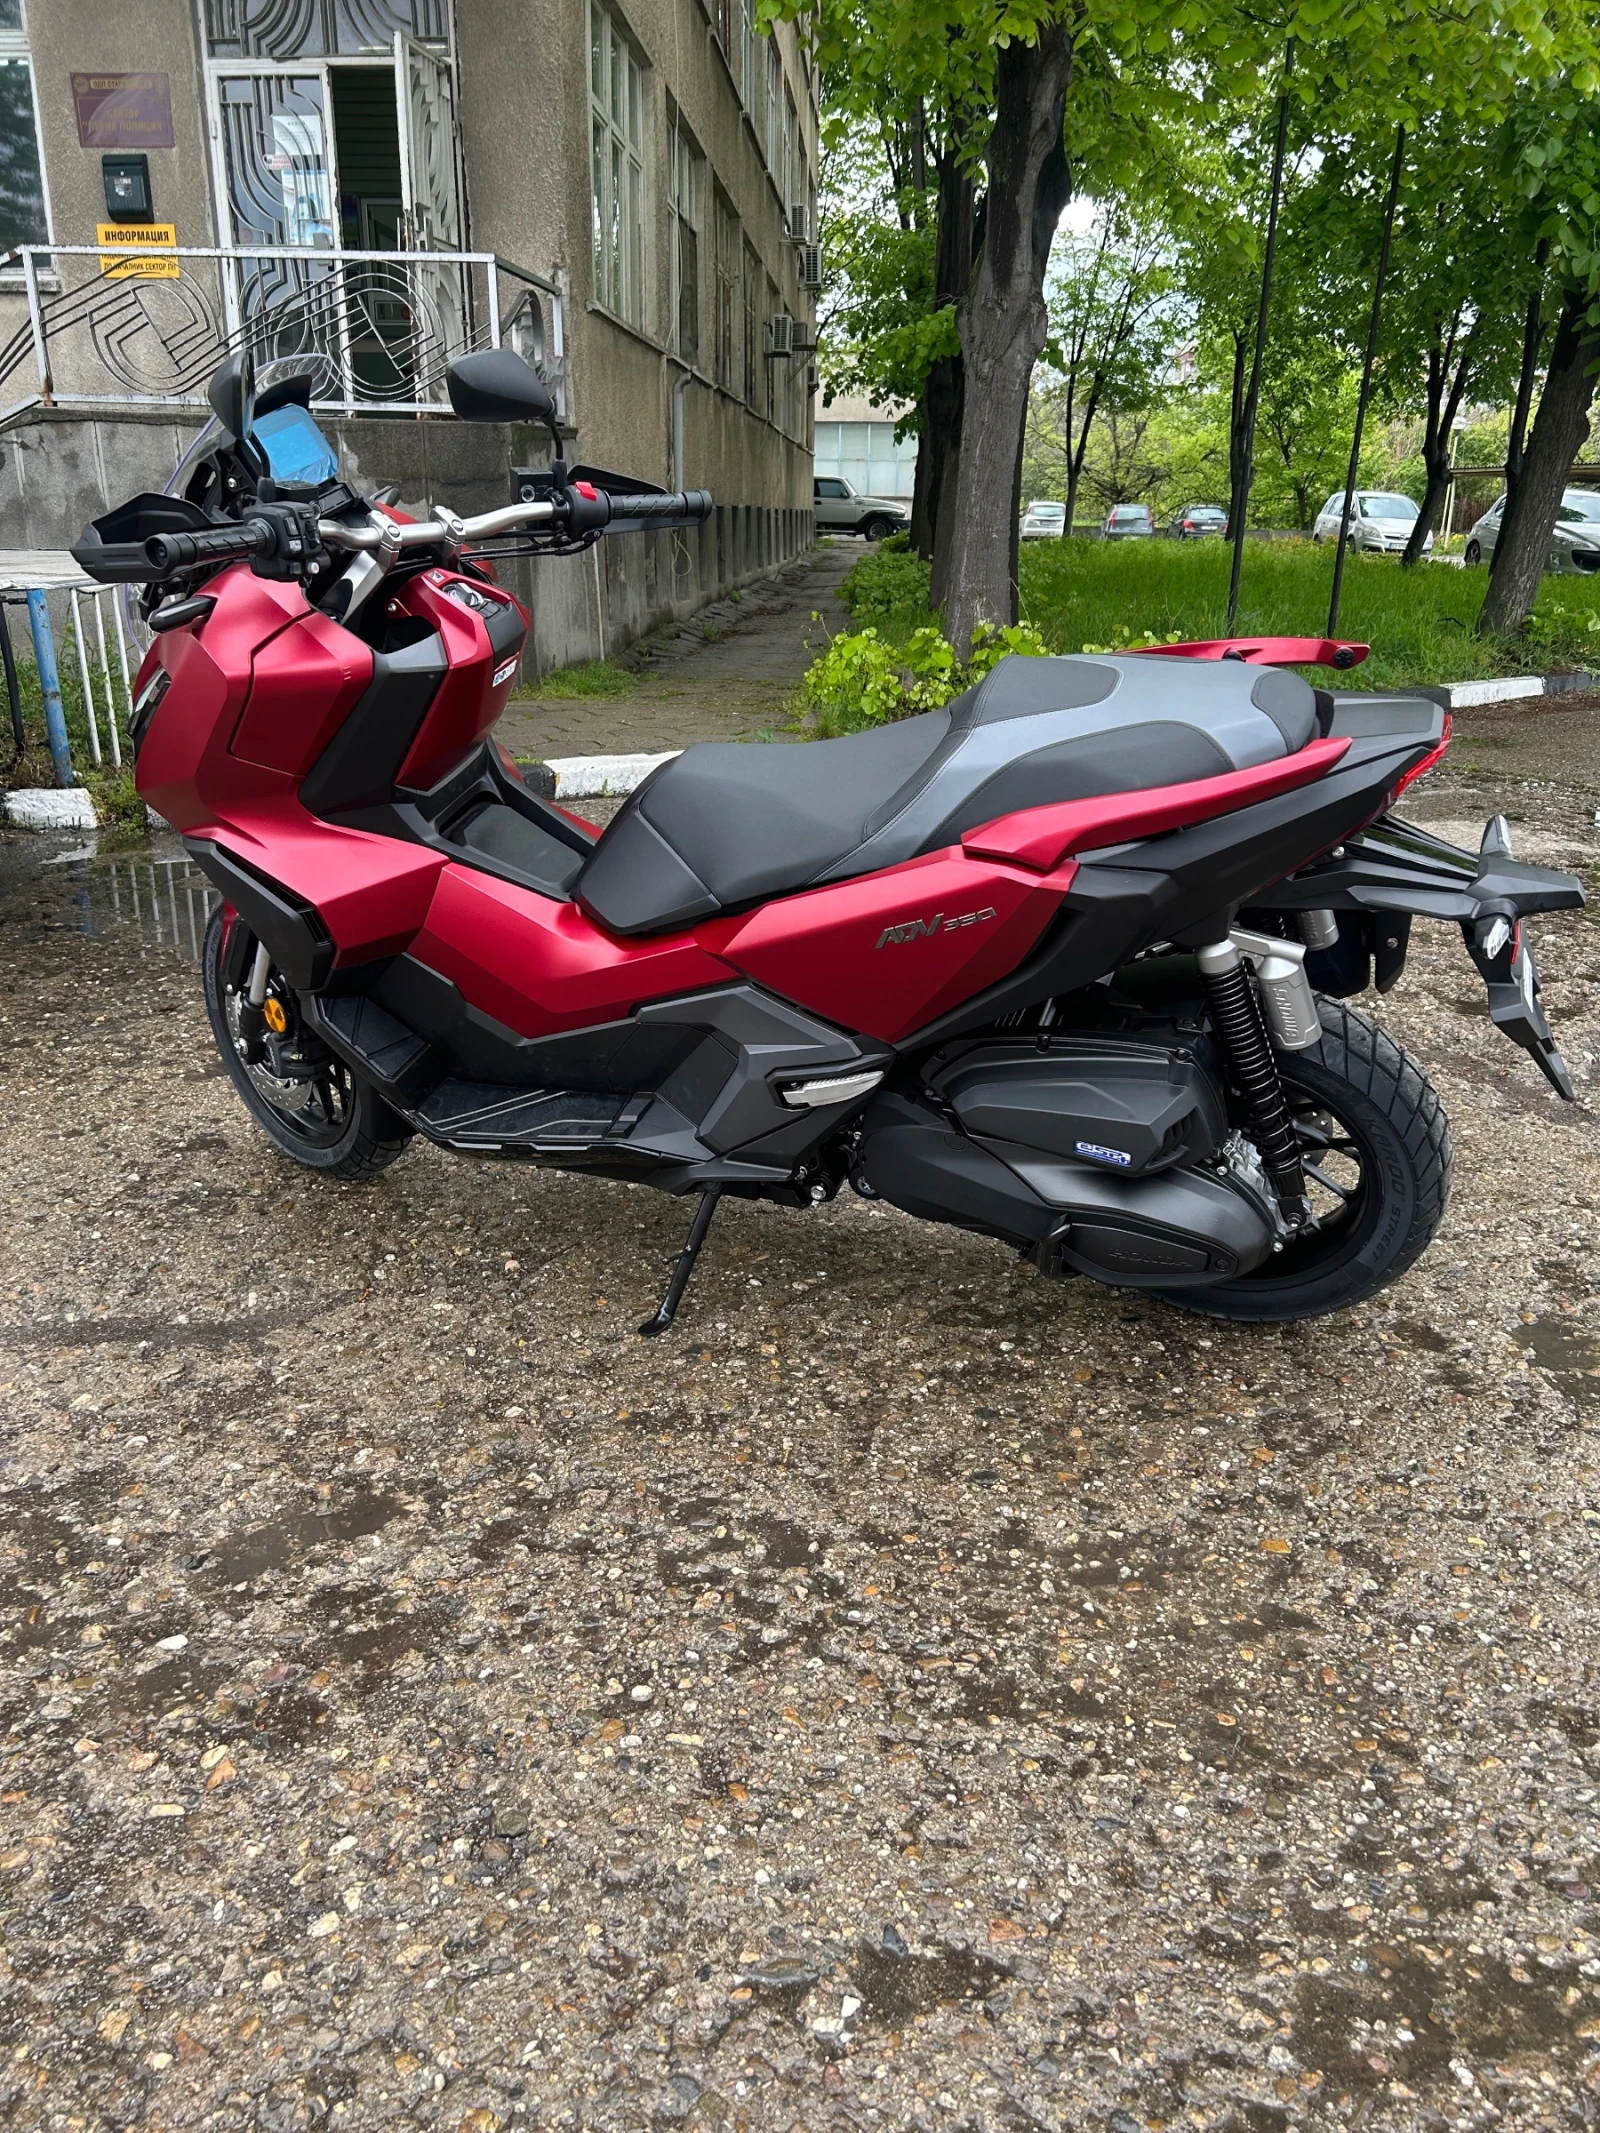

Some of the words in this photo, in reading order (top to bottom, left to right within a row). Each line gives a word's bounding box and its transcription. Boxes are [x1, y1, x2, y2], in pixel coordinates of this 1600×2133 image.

[105, 230, 169, 243] ИНФОРМАЦИЯ
[145, 262, 166, 271] СЕКТОР
[874, 912, 945, 950] ADV
[942, 906, 997, 932] 350
[1372, 1203, 1402, 1263] STREET
[1108, 1247, 1194, 1268] HONDA
